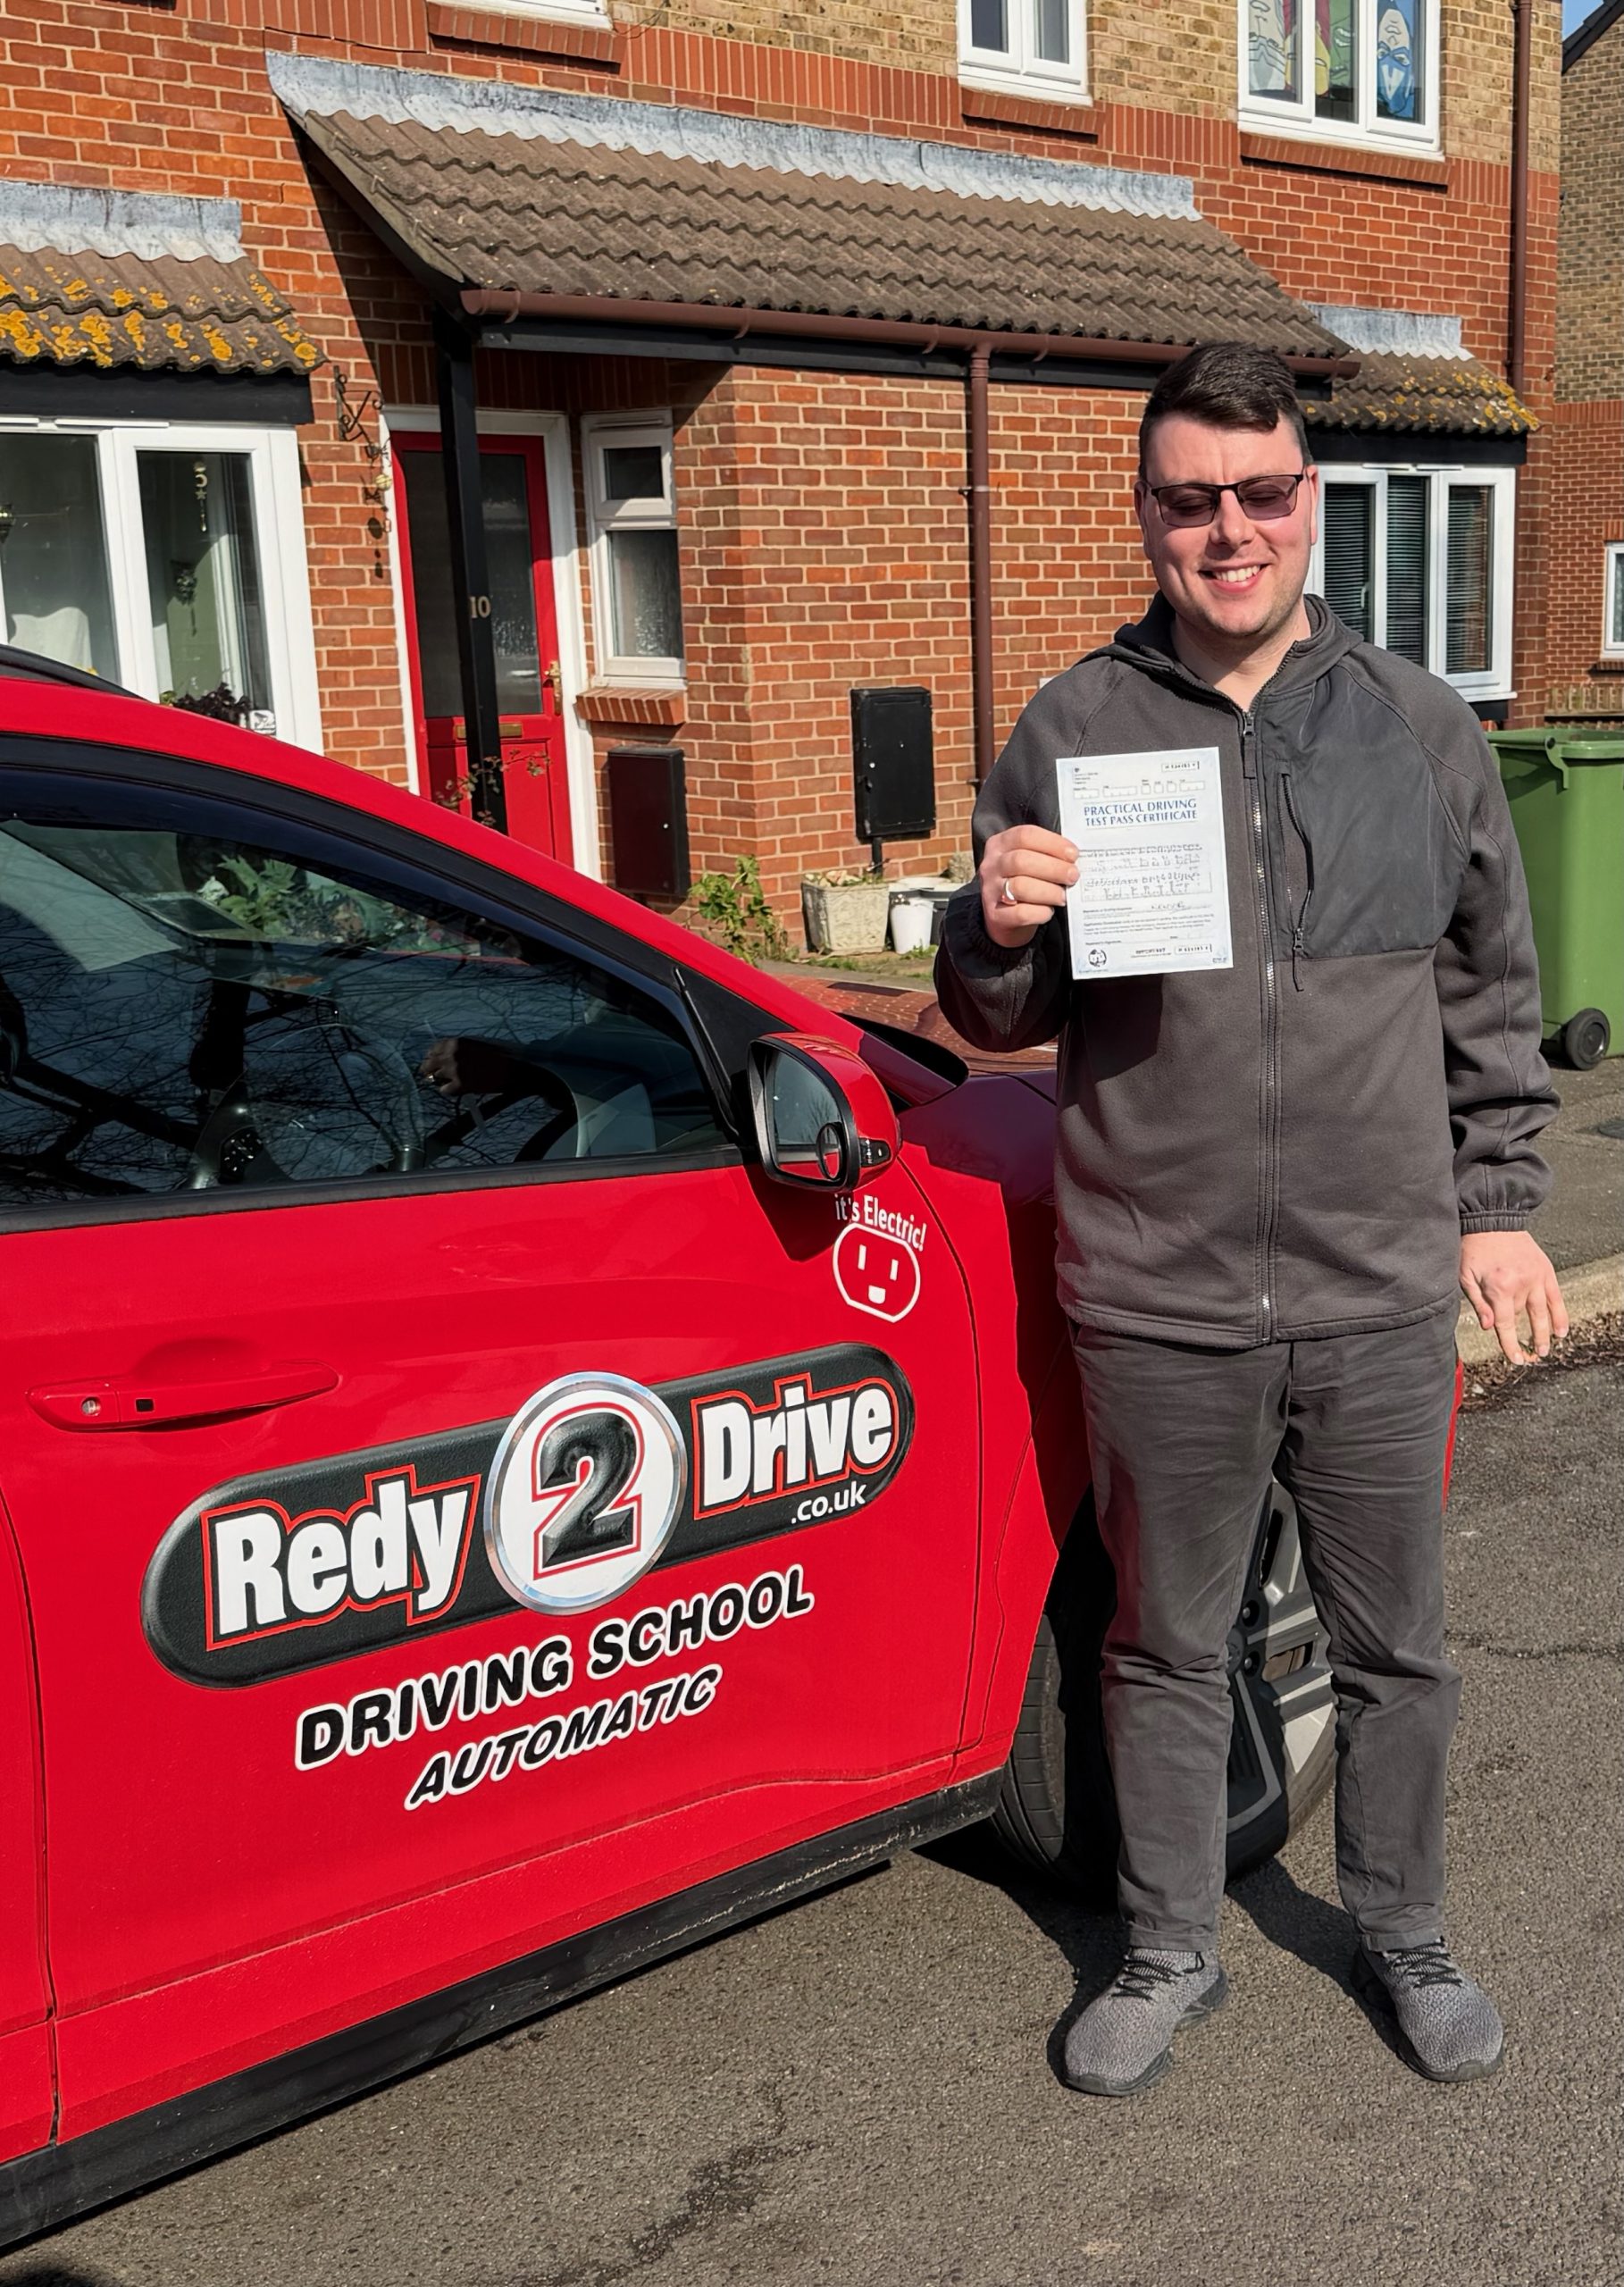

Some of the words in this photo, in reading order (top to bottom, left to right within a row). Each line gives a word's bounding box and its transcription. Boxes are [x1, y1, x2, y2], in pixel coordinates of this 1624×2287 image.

[469, 596, 491, 618] 10
[1084, 801, 1144, 817] PRACTICAL
[1147, 799, 1197, 812] DRIVING
[1085, 816, 1107, 826] TEST
[1110, 814, 1134, 825] PASS
[1136, 809, 1197, 823] CERTIFICATE
[863, 1194, 927, 1252] Electric!
[214, 1479, 469, 1635] Redy
[538, 1411, 638, 1571] 2
[701, 1386, 892, 1507] Drive
[791, 1481, 866, 1525] .co.uk
[296, 1636, 572, 1769] DRIVING
[587, 1564, 815, 1680] SCHOOL
[405, 1665, 722, 1810] AUTOMATIC
